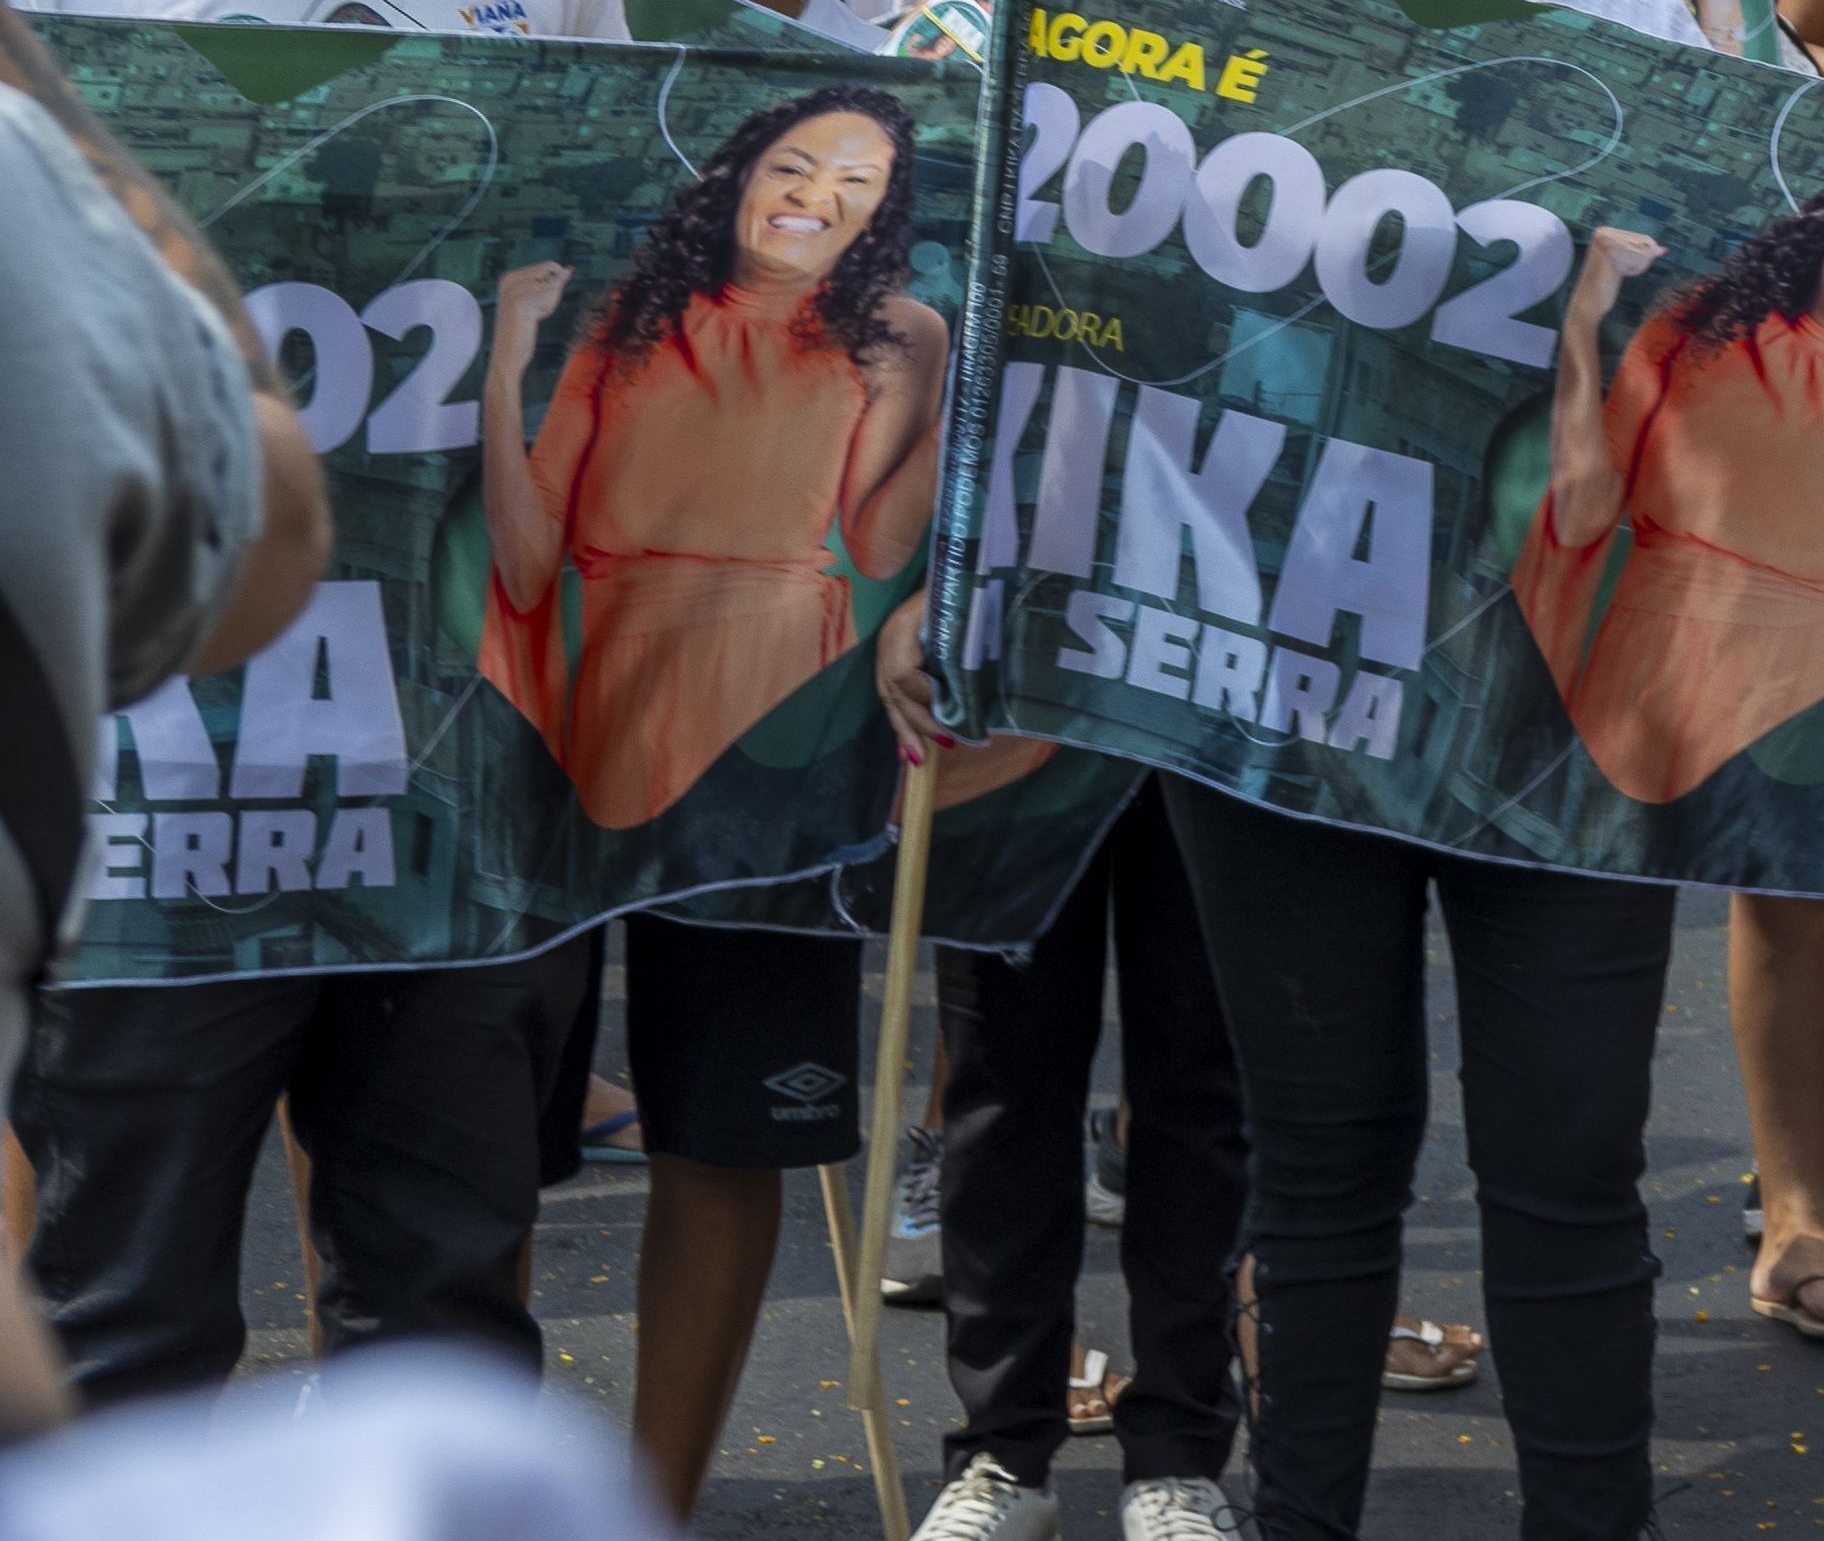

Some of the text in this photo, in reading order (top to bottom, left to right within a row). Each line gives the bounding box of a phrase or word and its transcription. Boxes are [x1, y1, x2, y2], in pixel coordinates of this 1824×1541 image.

[458, 0, 528, 26] VIANA
[1028, 8, 1269, 105] AGORA É
[1014, 82, 1574, 368] 20002
[954, 424, 986, 517] PODEMOS
[943, 523, 967, 605] PARTIDO
[1057, 591, 1403, 760] SERRA
[87, 806, 396, 900] ERRA
